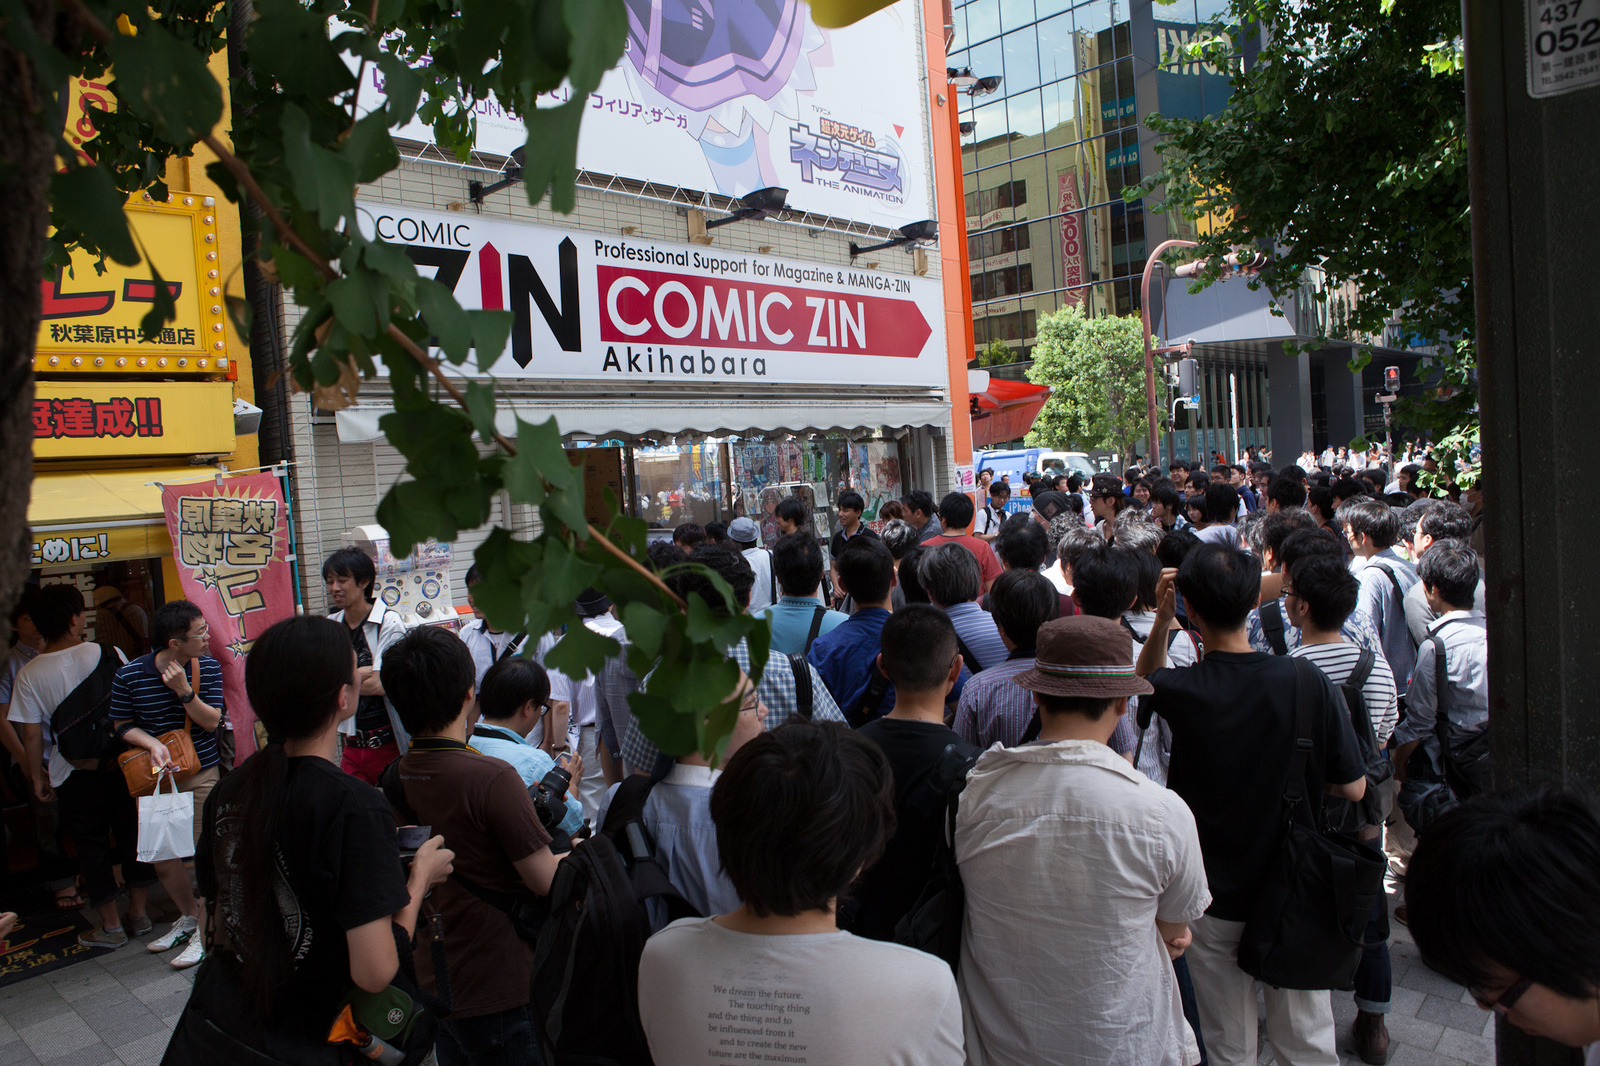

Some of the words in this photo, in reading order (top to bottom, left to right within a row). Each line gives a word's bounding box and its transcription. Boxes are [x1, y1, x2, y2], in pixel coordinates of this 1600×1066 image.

[1540, 0, 1582, 24] 437
[1535, 18, 1600, 56] 052
[1541, 50, 1600, 74] 第一建設事
[586, 92, 689, 129] フィリア・サーガ
[820, 117, 876, 148] 超次元ゲイム
[816, 177, 840, 190] THE
[843, 184, 904, 204] ANIMATION
[377, 214, 471, 248] COMIC
[594, 239, 689, 268] Professional
[692, 249, 747, 276] Support
[752, 260, 769, 277] for
[773, 264, 834, 288] Magazine
[837, 272, 845, 284] &
[848, 274, 911, 294] MANGA-ZIN
[606, 276, 794, 345] COMIC
[807, 297, 867, 349] ZIN
[602, 346, 767, 376] Akihabara
[713, 984, 728, 995] We
[729, 987, 756, 997] dream
[758, 989, 772, 998] the
[773, 990, 804, 1000] future.
[707, 1010, 723, 1020] and
[725, 1012, 739, 1021] the
[740, 1013, 763, 1024] thing
[764, 1015, 781, 1024] and
[783, 1016, 793, 1025] to
[729, 999, 745, 1009] The
[746, 1001, 785, 1014] touching
[787, 1004, 811, 1015] thing
[708, 1023, 718, 1032] be
[719, 1024, 763, 1036] influenced
[765, 1027, 786, 1037] from
[788, 1029, 795, 1038] it
[708, 1047, 732, 1059] future
[734, 1051, 747, 1060] are
[749, 1052, 762, 1061] the
[764, 1053, 807, 1064] maximum
[719, 1037, 735, 1046] and
[737, 1038, 746, 1047] to
[747, 1039, 772, 1049] create
[774, 1041, 787, 1050] the
[789, 1042, 808, 1051] new
